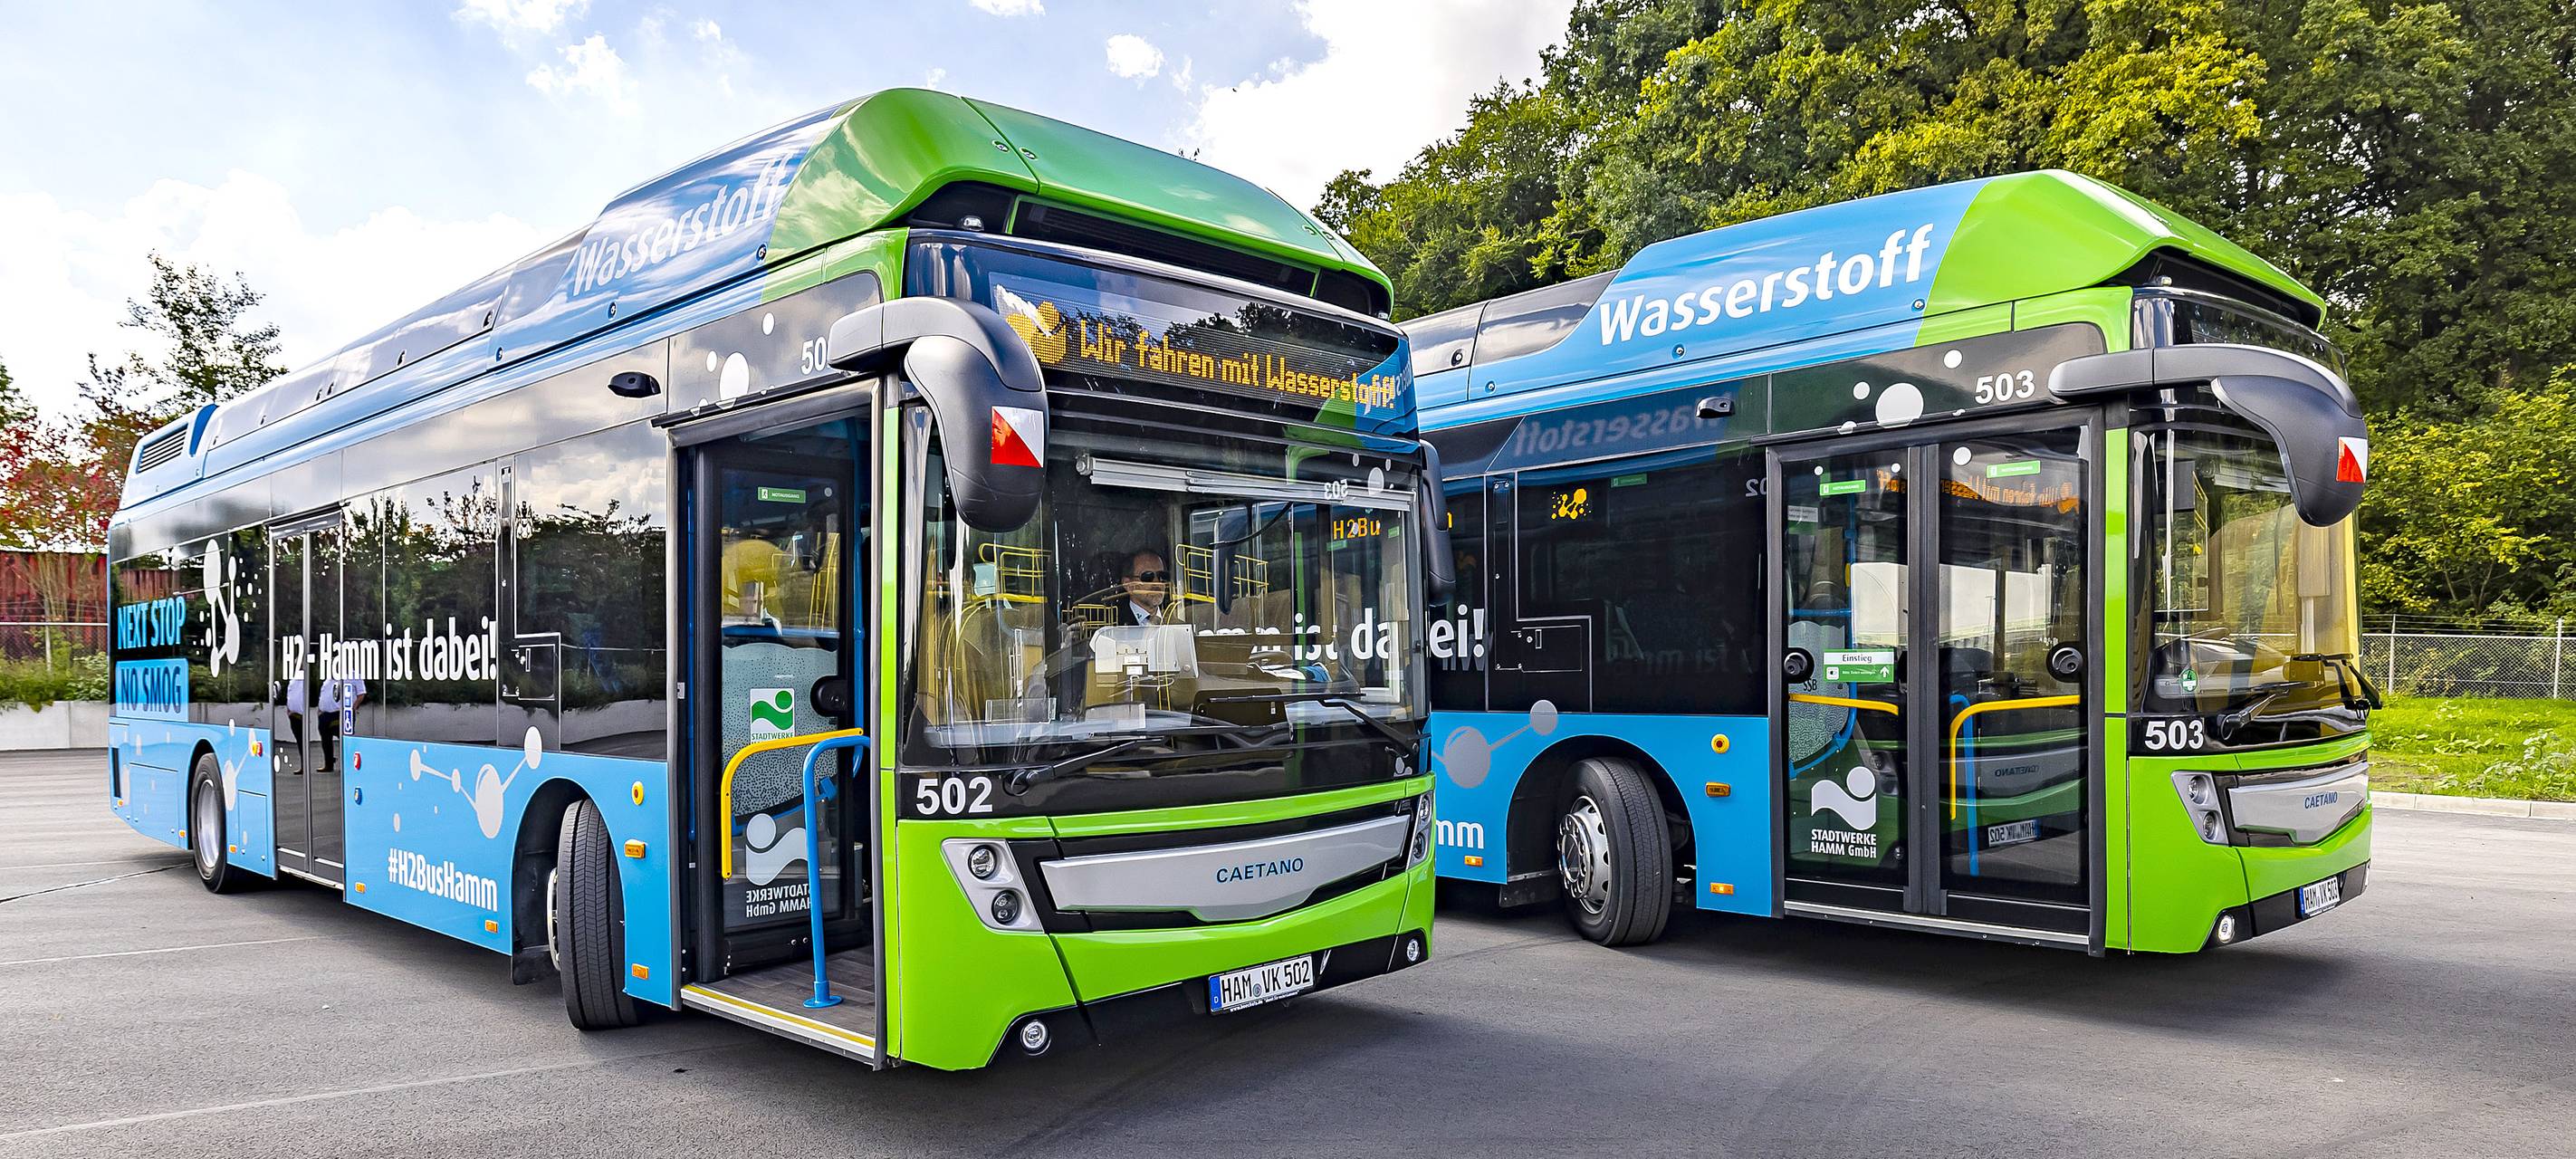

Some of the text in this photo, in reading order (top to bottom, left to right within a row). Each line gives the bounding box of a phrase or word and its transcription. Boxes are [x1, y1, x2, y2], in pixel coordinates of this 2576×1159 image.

[573, 152, 794, 296] Wasserstoff
[1599, 223, 1934, 346] Wasserstoff
[800, 336, 832, 376] 50
[1080, 319, 1126, 363] Wir
[1135, 329, 1214, 378] fahren
[1221, 352, 1259, 387] mit
[1266, 354, 1395, 409] Wasserstoff!
[1975, 369, 2035, 405] 503
[118, 596, 187, 649] NEXT STOP
[1351, 604, 1485, 659] daei!
[386, 623, 413, 681] ist
[419, 616, 497, 681] dabei!
[1842, 655, 1872, 663] Einstieg
[120, 666, 181, 714] NO SMOG
[752, 732, 793, 741] STADTWERKE
[2144, 720, 2204, 751] 503
[916, 776, 992, 815] 502
[2304, 791, 2338, 809] CAETANO
[1811, 829, 1877, 846] STADTWERKE
[1811, 841, 1877, 858] HAMM GmbH
[388, 848, 498, 913] #H2BusHamm
[1216, 857, 1304, 884] CAETANO
[2304, 887, 2318, 910] HAM
[1221, 973, 1252, 1004] HAM
[1261, 966, 1281, 993] VK
[1283, 960, 1310, 988] 502
